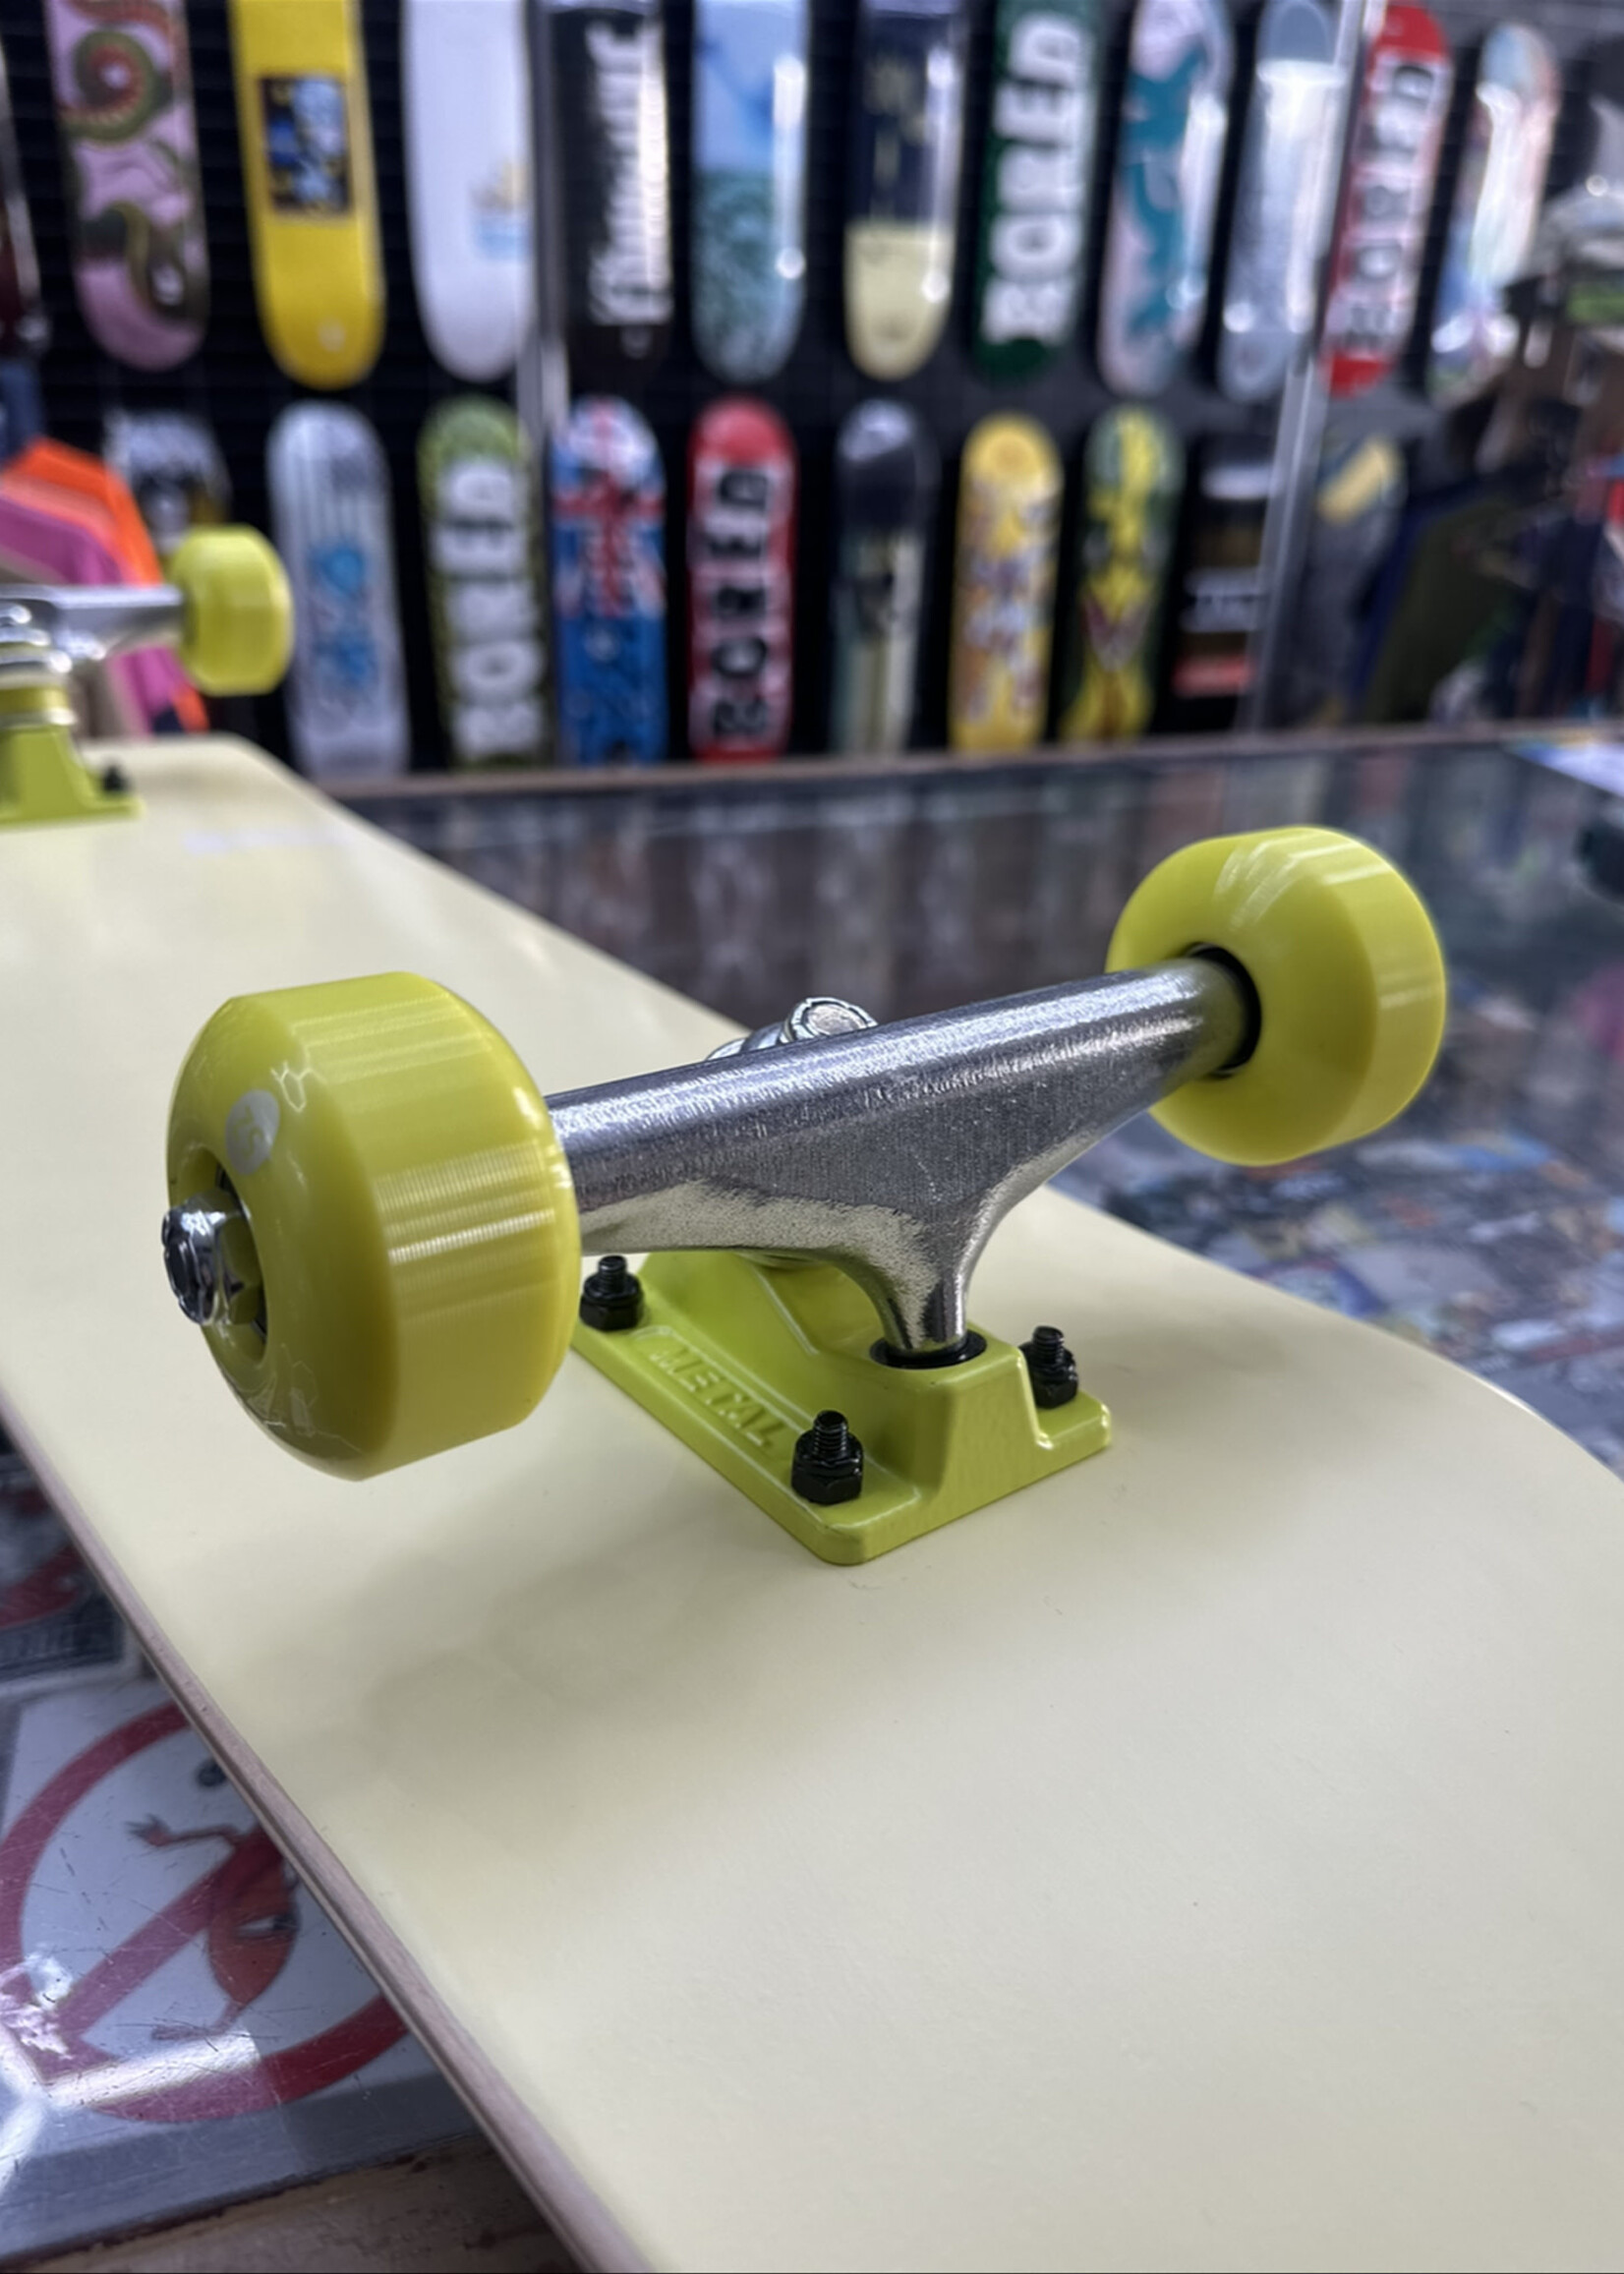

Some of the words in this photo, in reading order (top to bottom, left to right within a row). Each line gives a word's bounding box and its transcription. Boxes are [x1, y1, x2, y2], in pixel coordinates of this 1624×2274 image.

[984, 18, 1087, 342] BORED
[435, 460, 543, 761] BORED
[706, 464, 775, 739] BORED
[650, 1348, 784, 1448] METAL
